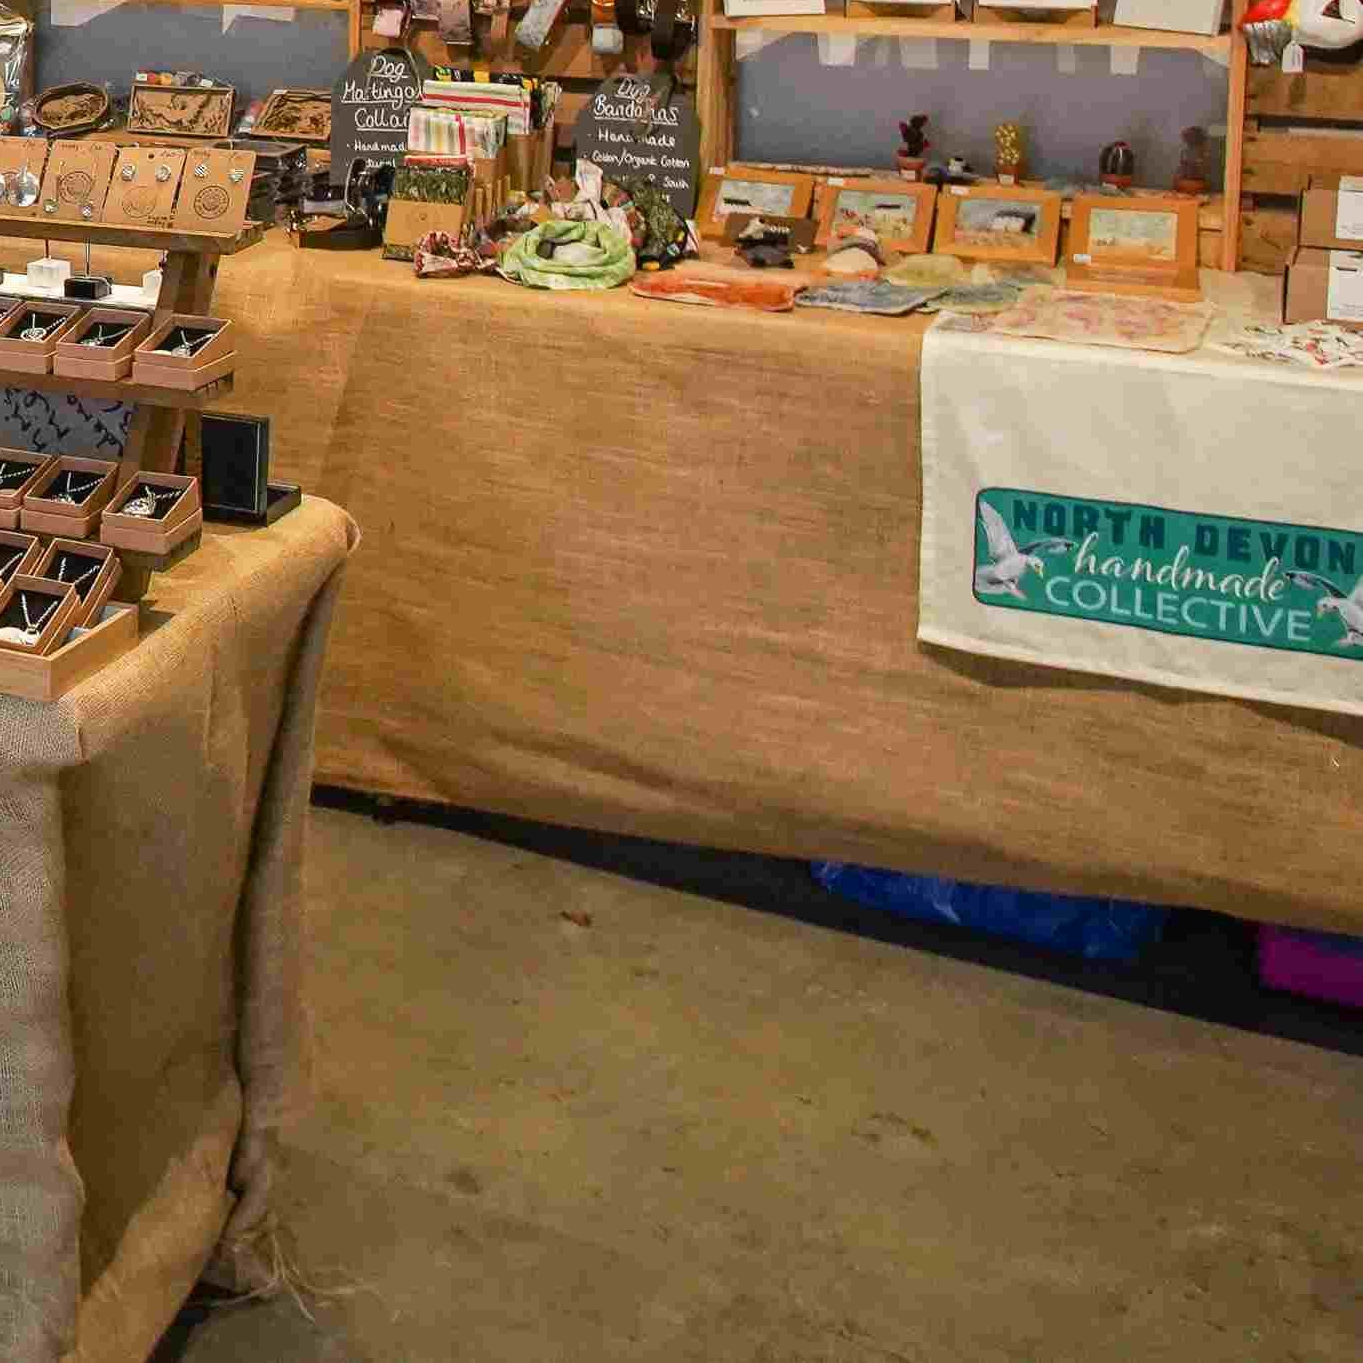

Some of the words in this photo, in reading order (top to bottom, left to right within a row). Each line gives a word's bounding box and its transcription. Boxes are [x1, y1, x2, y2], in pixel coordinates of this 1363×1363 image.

[369, 55, 406, 83] Dog
[355, 138, 406, 152] Handmad
[1012, 499, 1165, 549] NORTH
[1196, 523, 1356, 574] DEVON
[1074, 531, 1286, 602] handmade
[1045, 574, 1312, 641] COLLECTIVE
